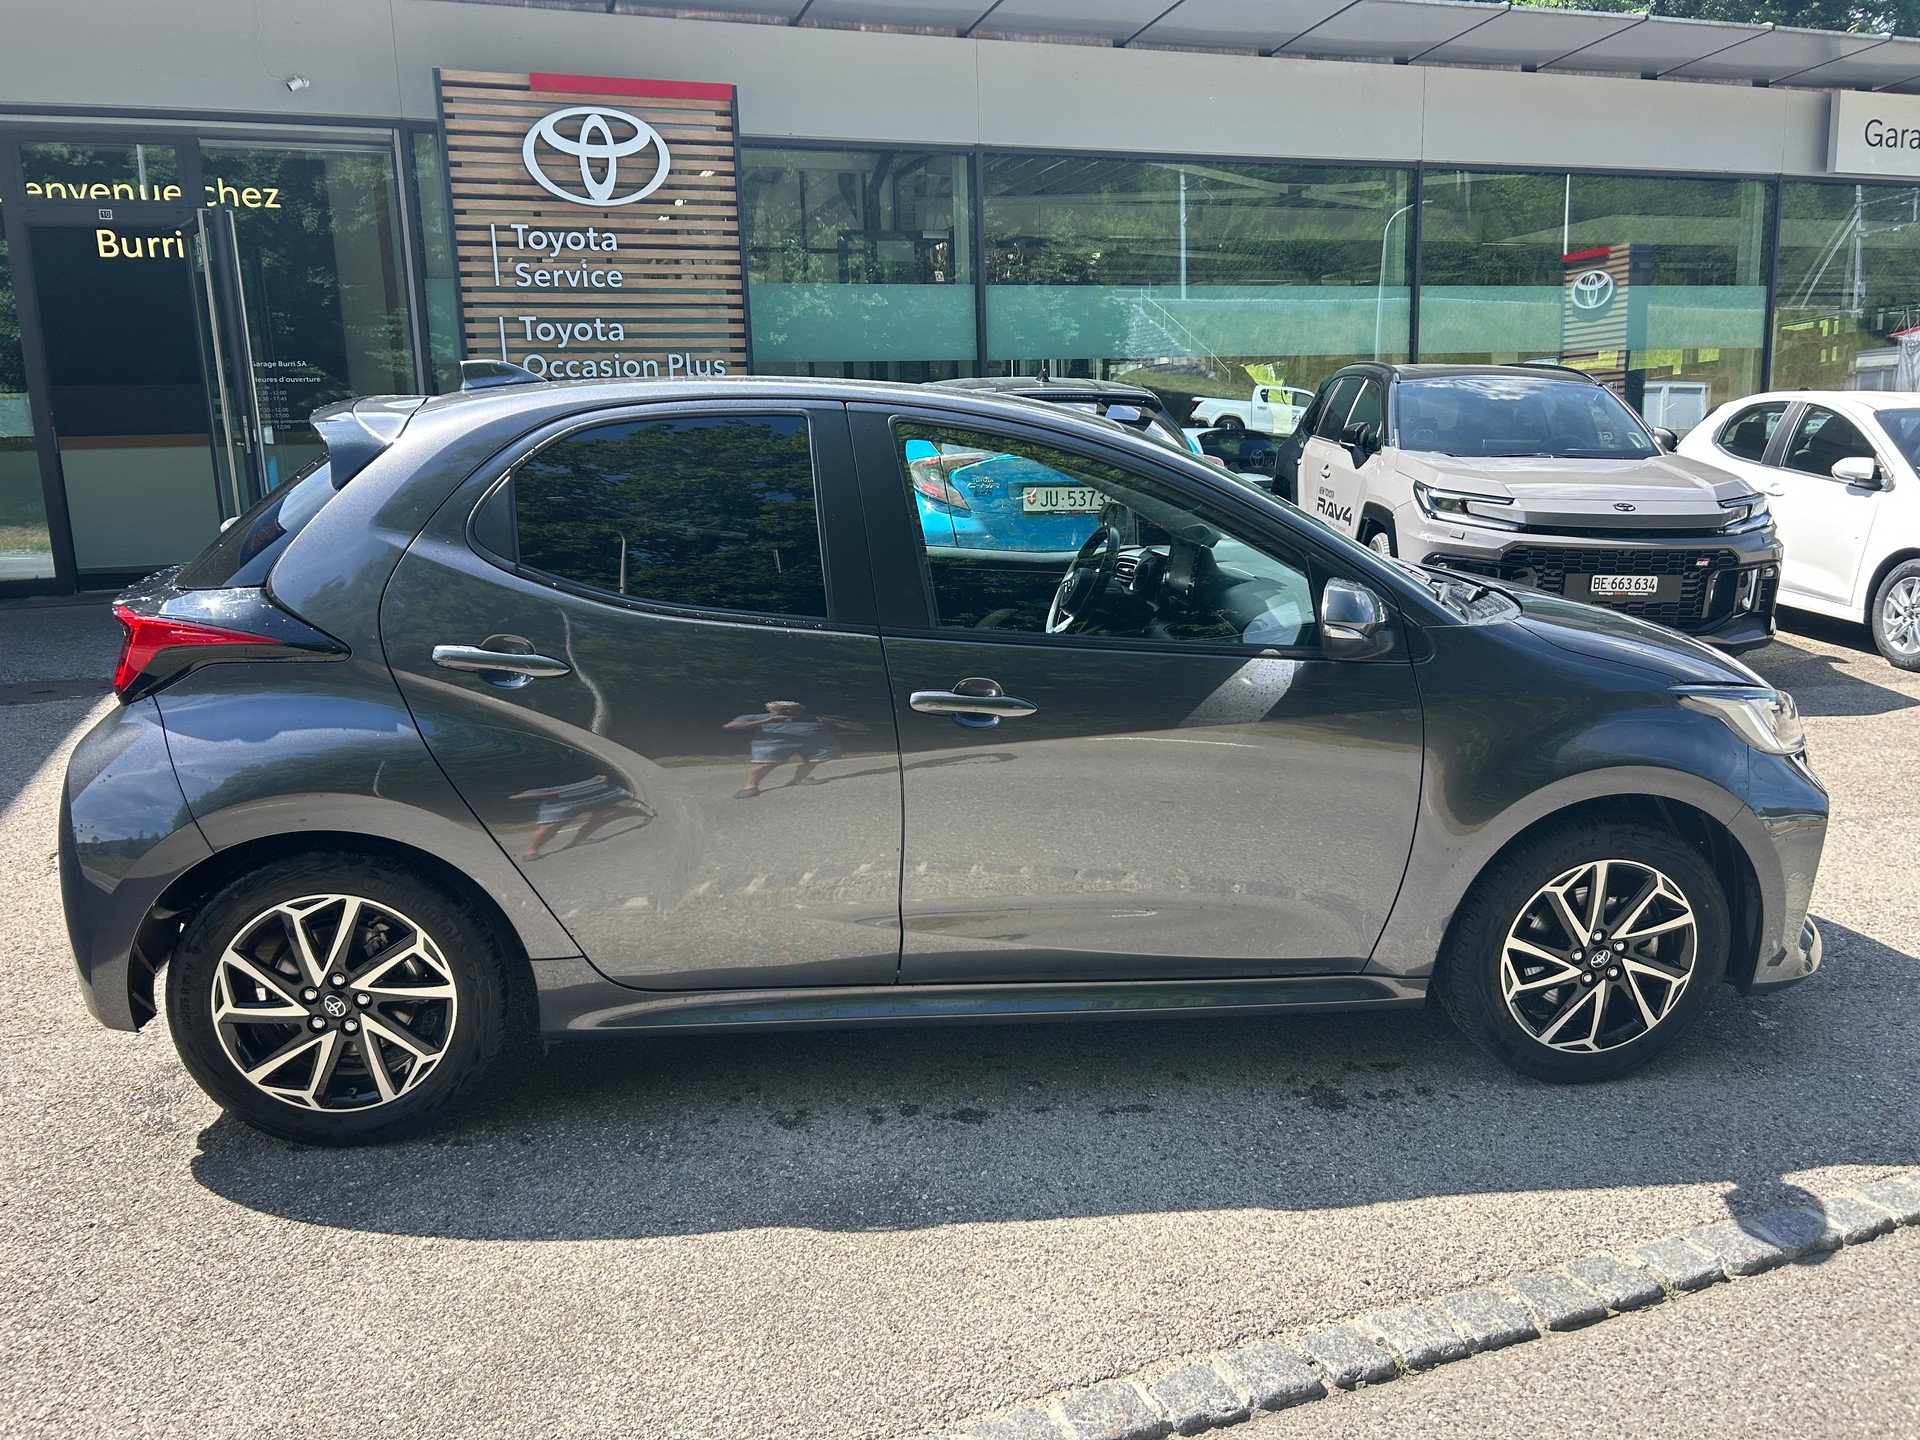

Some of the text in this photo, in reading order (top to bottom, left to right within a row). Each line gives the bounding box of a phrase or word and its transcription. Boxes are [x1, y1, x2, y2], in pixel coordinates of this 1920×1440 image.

[1864, 118, 1920, 150] Gara
[26, 177, 283, 209] envenue chez
[96, 229, 185, 259] Burri
[510, 223, 619, 257] Toyota
[515, 262, 623, 289] Service
[518, 315, 626, 349] Toyota
[522, 353, 727, 379] Occasion Plus
[1317, 497, 1352, 526] RAV4
